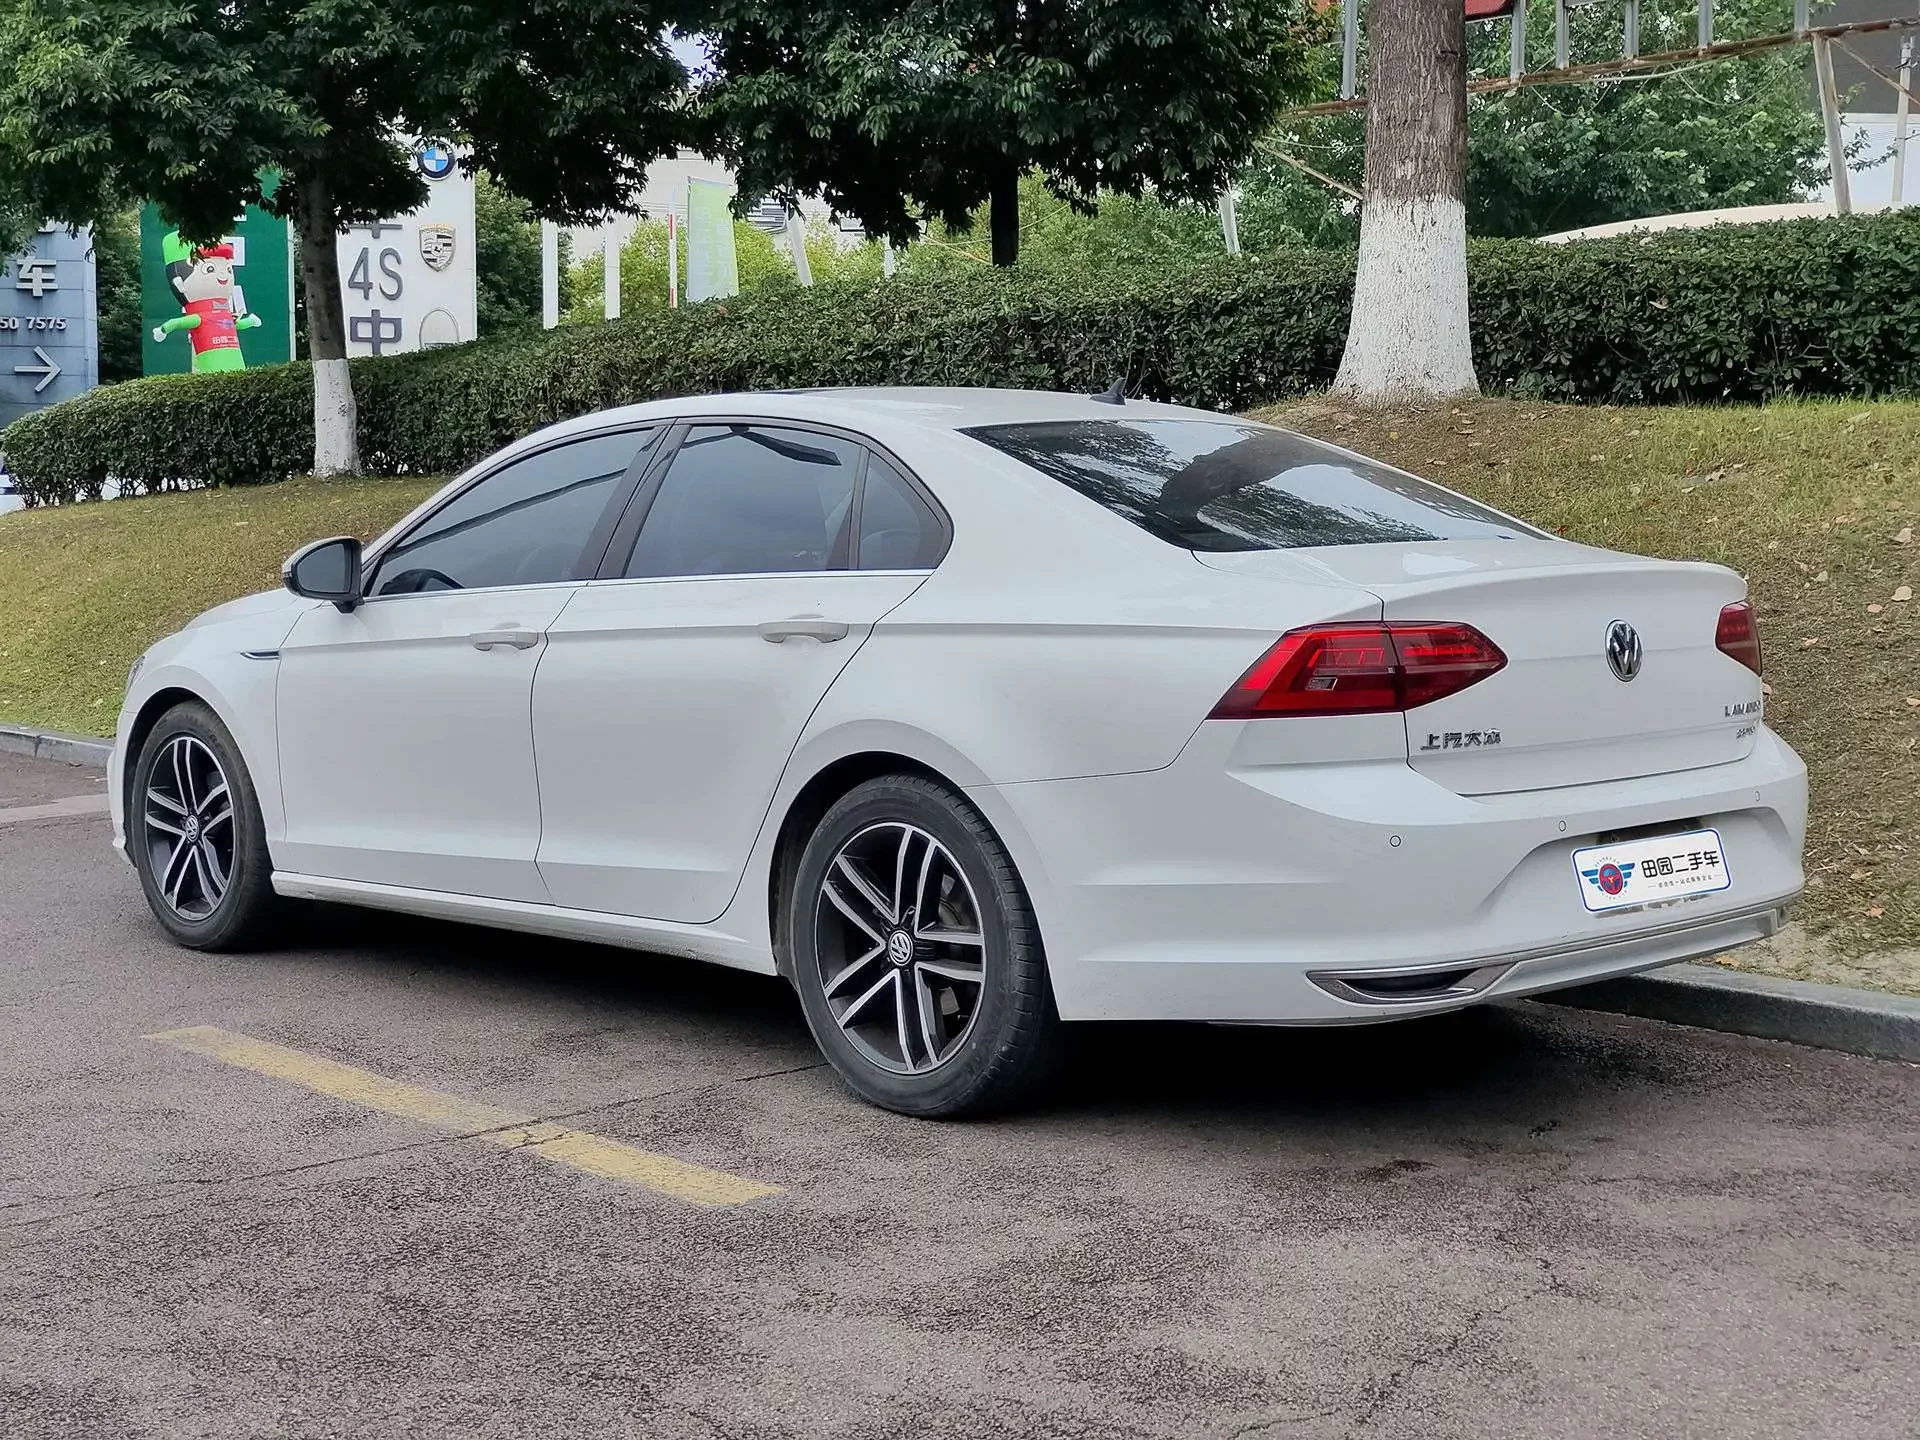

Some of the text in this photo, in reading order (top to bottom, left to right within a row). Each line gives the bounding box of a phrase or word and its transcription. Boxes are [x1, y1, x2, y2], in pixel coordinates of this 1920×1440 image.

[26, 316, 68, 330] 7575
[1641, 851, 1720, 878] 田园二手车
